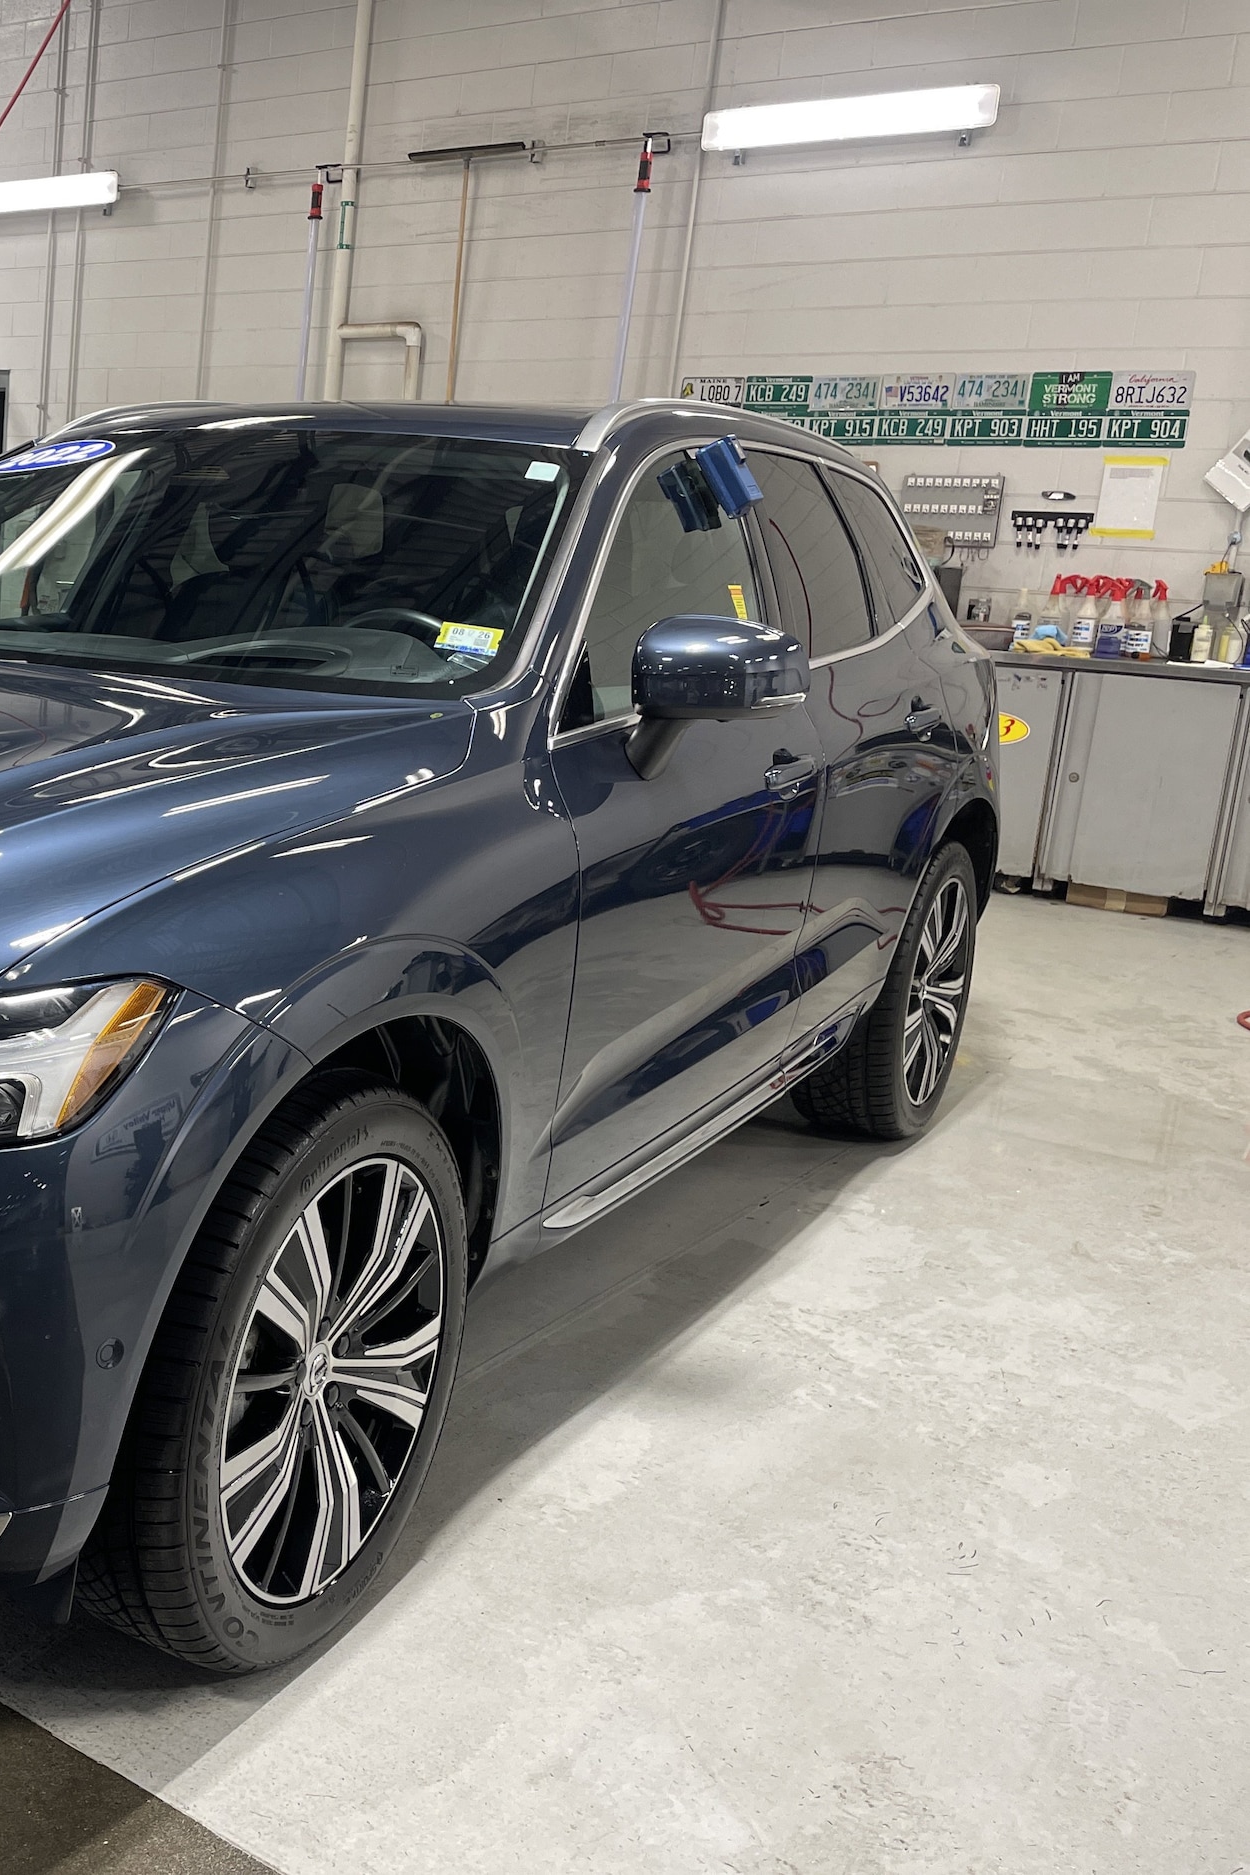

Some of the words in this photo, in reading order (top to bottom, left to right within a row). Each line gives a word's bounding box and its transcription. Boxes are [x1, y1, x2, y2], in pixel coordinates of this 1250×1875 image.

[1067, 373, 1081, 382] AM
[1129, 374, 1178, 386] California
[734, 385, 742, 401] 7
[750, 385, 774, 402] KCB
[781, 384, 806, 402] 249
[814, 382, 838, 399] 474
[846, 381, 876, 399] 2341
[899, 385, 949, 402] V53642
[958, 380, 984, 398] 474
[992, 379, 1026, 398] 2341
[1043, 383, 1098, 393] VERMONT
[1115, 386, 1187, 403] 8RIJ632
[1042, 393, 1096, 404] STRONG
[812, 420, 837, 437] KPT
[845, 419, 871, 437] 915
[881, 419, 908, 436] KCB
[915, 419, 943, 437] 249
[954, 419, 982, 437] KPT
[990, 419, 1019, 437] 903
[1030, 419, 1060, 438] HHT
[1068, 419, 1098, 438] 195
[1111, 419, 1141, 438] KPT
[1150, 419, 1181, 438] 904
[193, 1325, 258, 1648] CONTINENTAL
